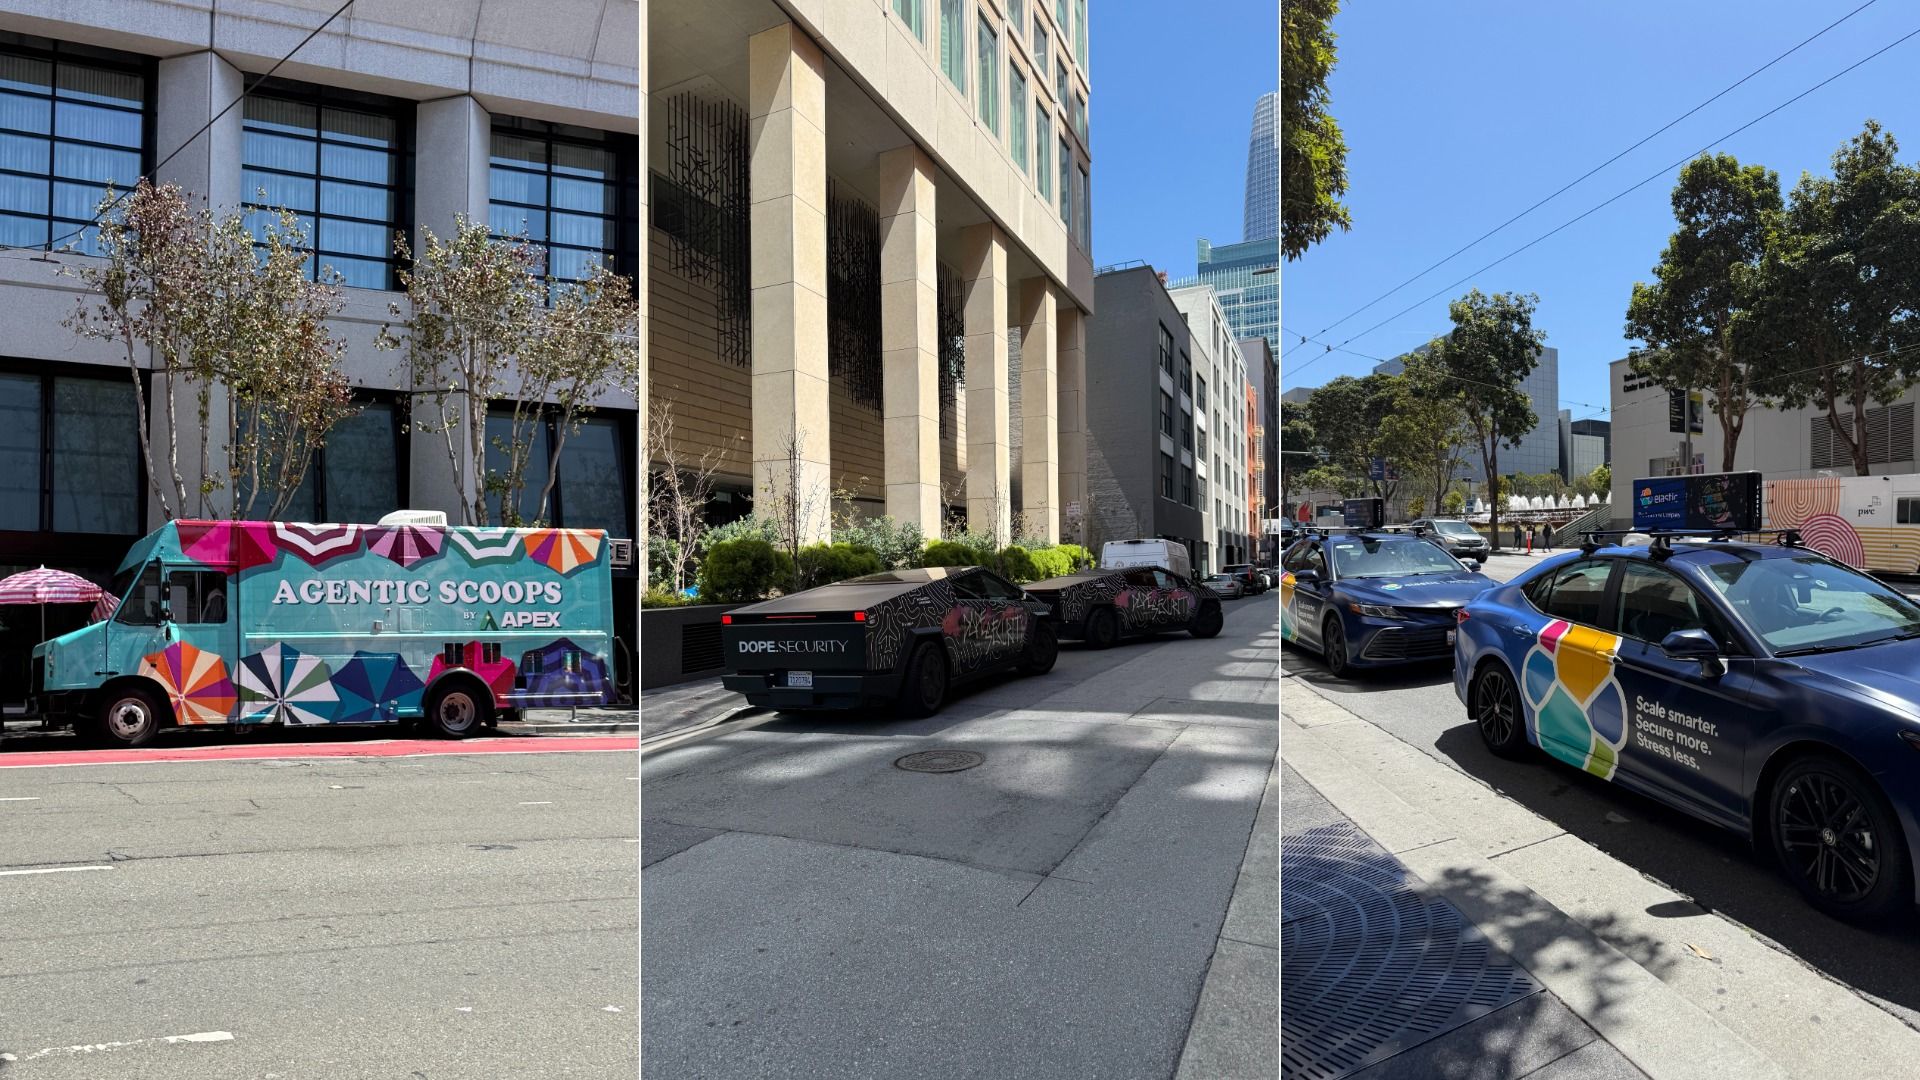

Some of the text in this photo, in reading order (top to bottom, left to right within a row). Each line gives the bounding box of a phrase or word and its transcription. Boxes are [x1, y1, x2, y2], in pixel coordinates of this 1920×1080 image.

[1858, 509, 1876, 517] pwc
[271, 579, 562, 605] AGENTIC SCOOPS
[463, 611, 561, 628] BY APEX
[1636, 695, 1719, 737] Scale smarter.
[1636, 713, 1712, 756] Secure more.
[1636, 731, 1700, 770] Stress less.
